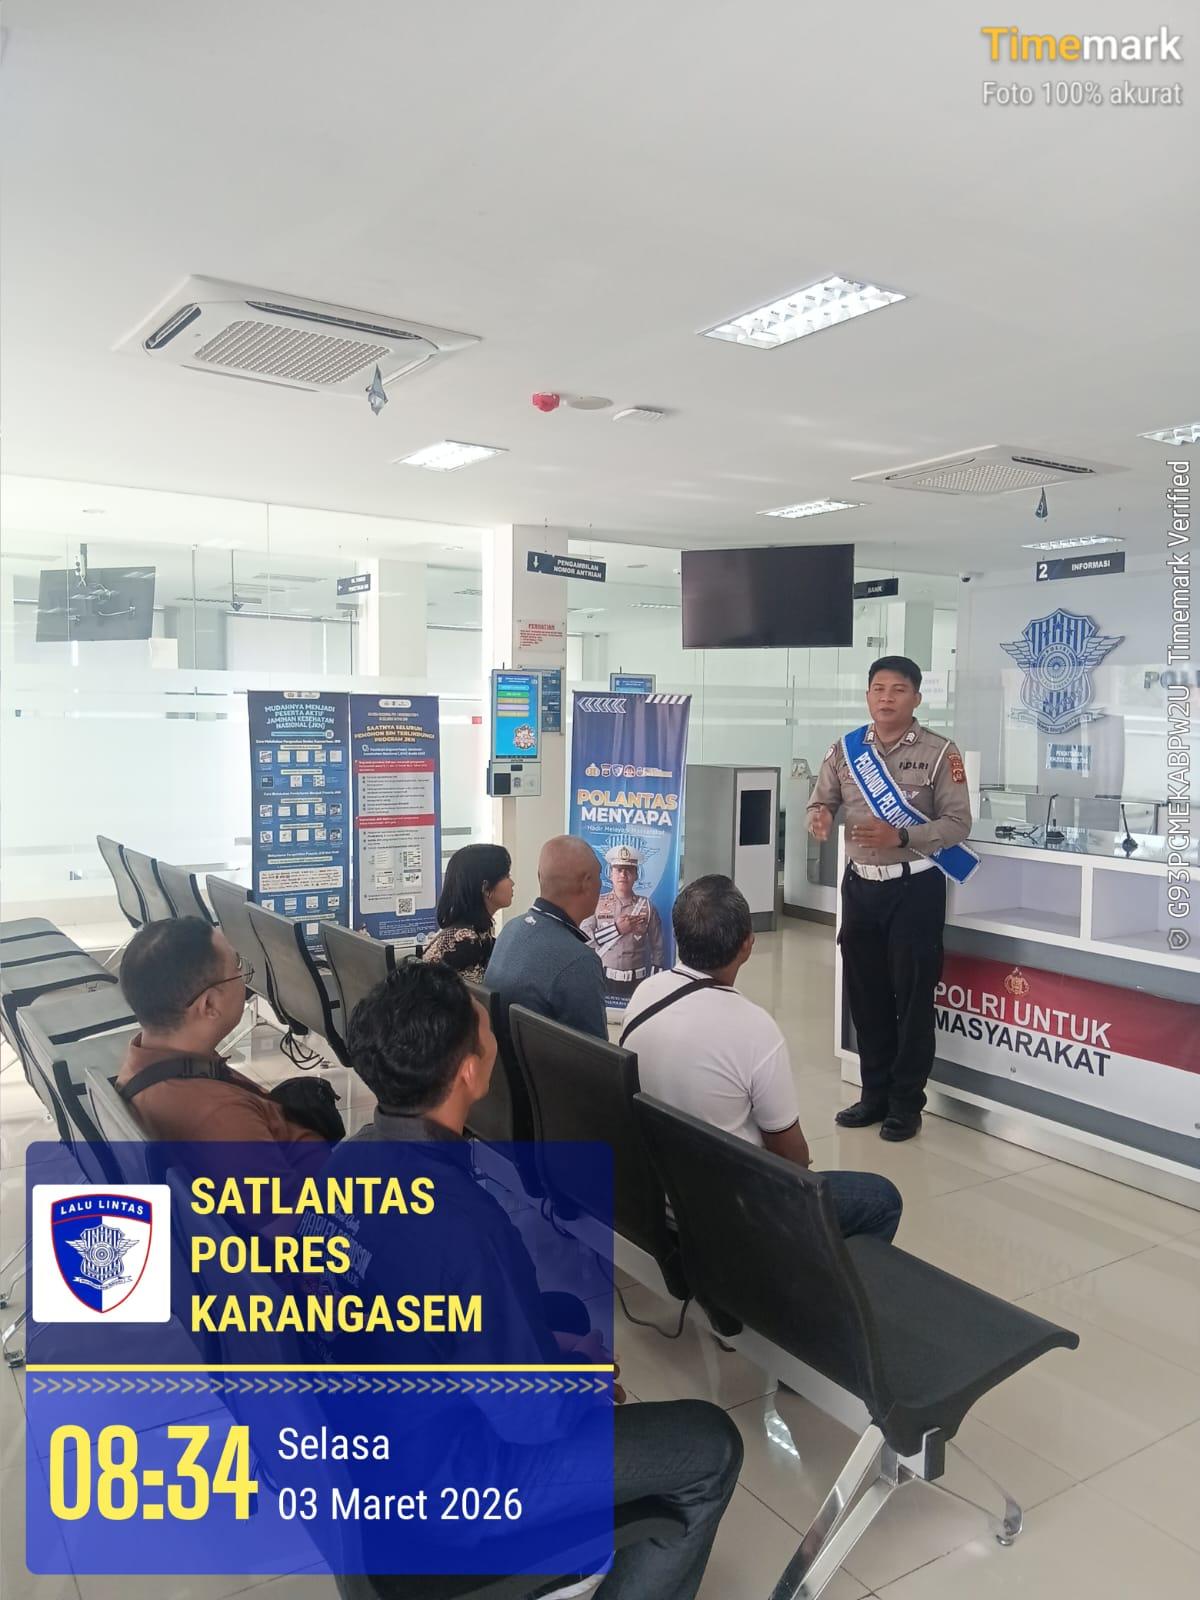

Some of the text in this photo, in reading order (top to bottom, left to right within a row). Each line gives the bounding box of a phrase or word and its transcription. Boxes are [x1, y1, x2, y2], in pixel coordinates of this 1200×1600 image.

[553, 566, 602, 578] NOMOR ANTRIAN
[557, 559, 599, 571] PENGAMBILAN
[1039, 560, 1111, 579] 2 INFORMASI
[264, 704, 335, 713] MUDAHNYA MENJADI
[266, 716, 334, 724] JAMINAN KESEHATAN
[308, 721, 325, 730] (JKN)
[853, 752, 889, 798] PEMANDU
[577, 788, 679, 811] POLANTAS
[581, 806, 672, 826] MENYAPA
[933, 981, 1112, 1048] POLRI UNTUK
[934, 1010, 1111, 1077] MASYARAKAT
